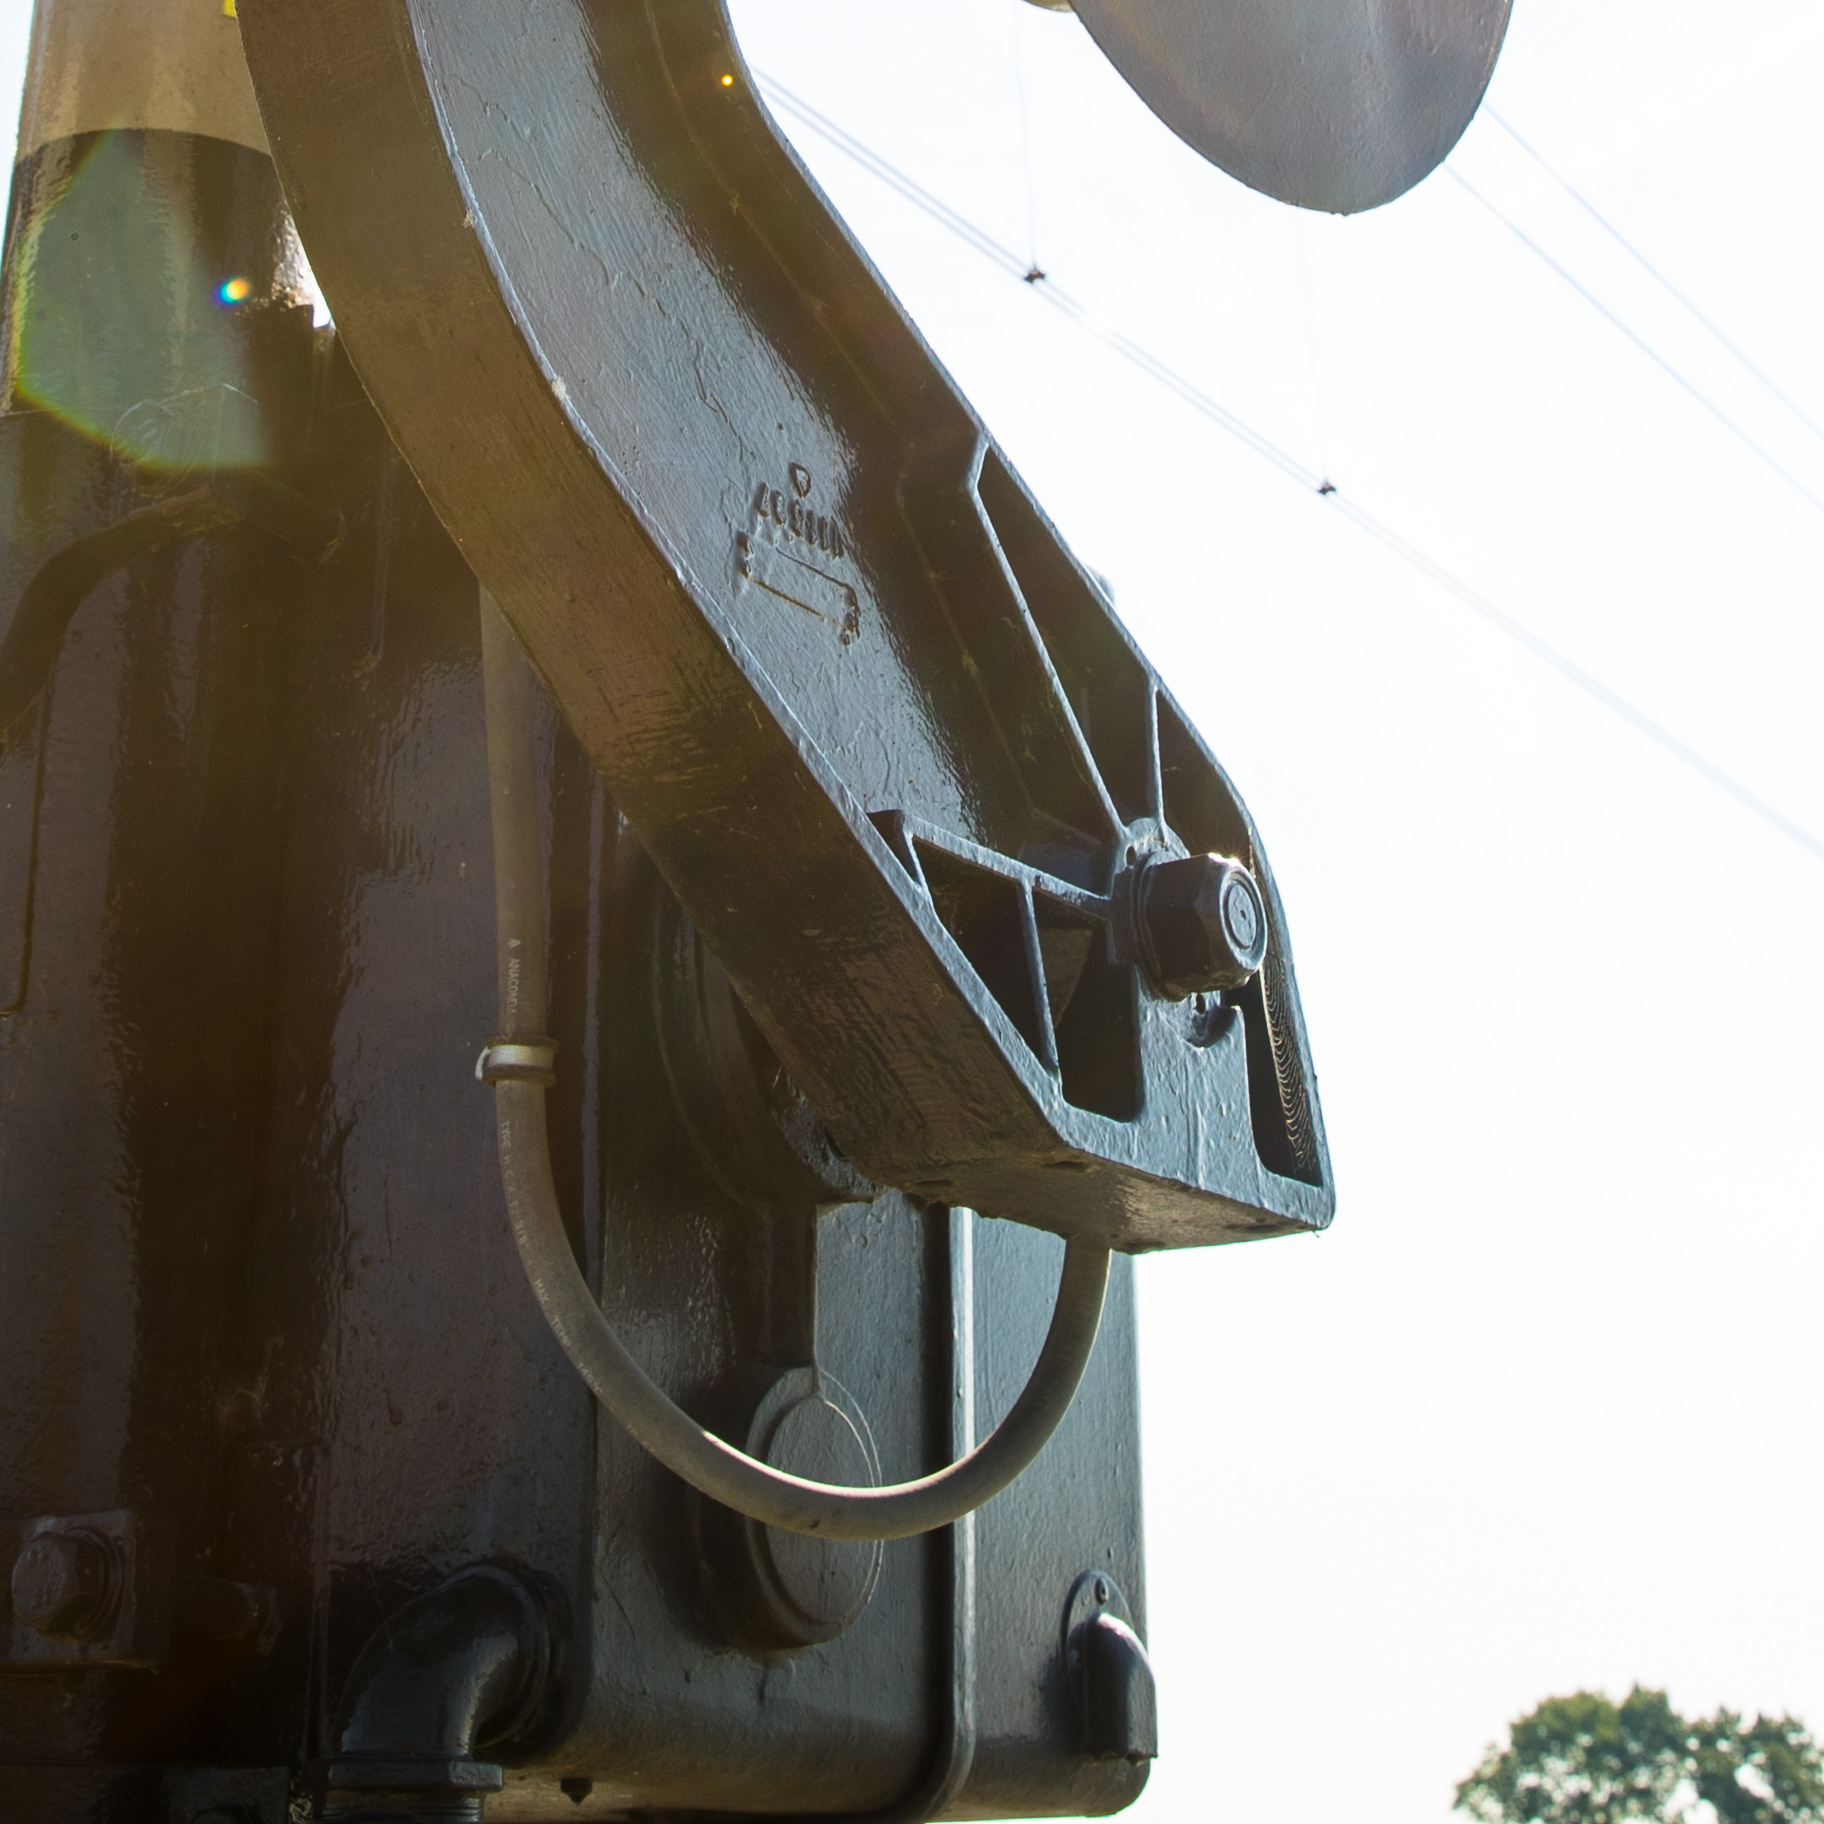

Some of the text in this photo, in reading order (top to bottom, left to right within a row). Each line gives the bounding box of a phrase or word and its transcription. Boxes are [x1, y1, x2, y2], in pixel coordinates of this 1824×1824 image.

[506, 958, 520, 1014] ANACONDA
[500, 1121, 511, 1149] TYPE
[533, 1278, 550, 1304] MAX
[550, 1315, 572, 1347] TEMP
